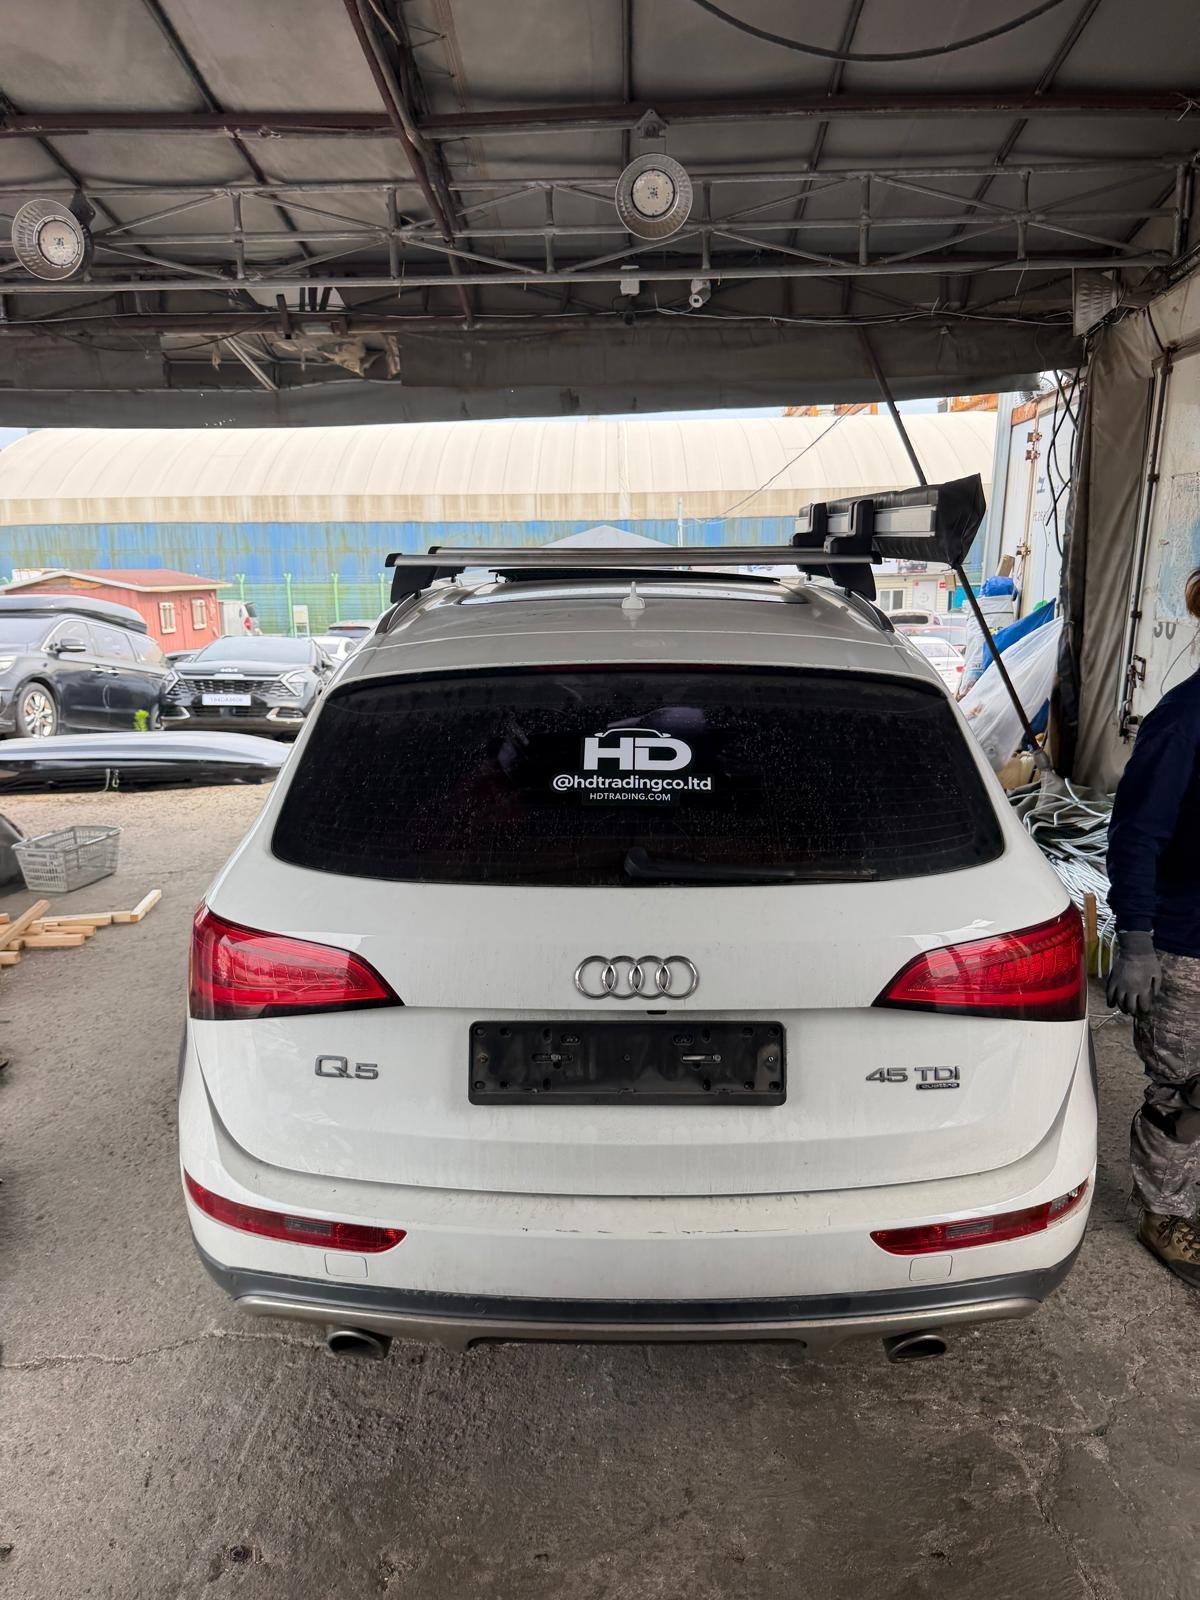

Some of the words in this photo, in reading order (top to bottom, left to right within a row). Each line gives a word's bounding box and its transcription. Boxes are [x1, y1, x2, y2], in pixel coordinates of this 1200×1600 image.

[583, 737, 692, 771] HD
[552, 774, 712, 792] @hdtradingco.ltd
[589, 792, 671, 801] HDTRADING.COM
[314, 1054, 379, 1080] Q5
[865, 1067, 909, 1083] 45
[914, 1065, 961, 1082] TDI
